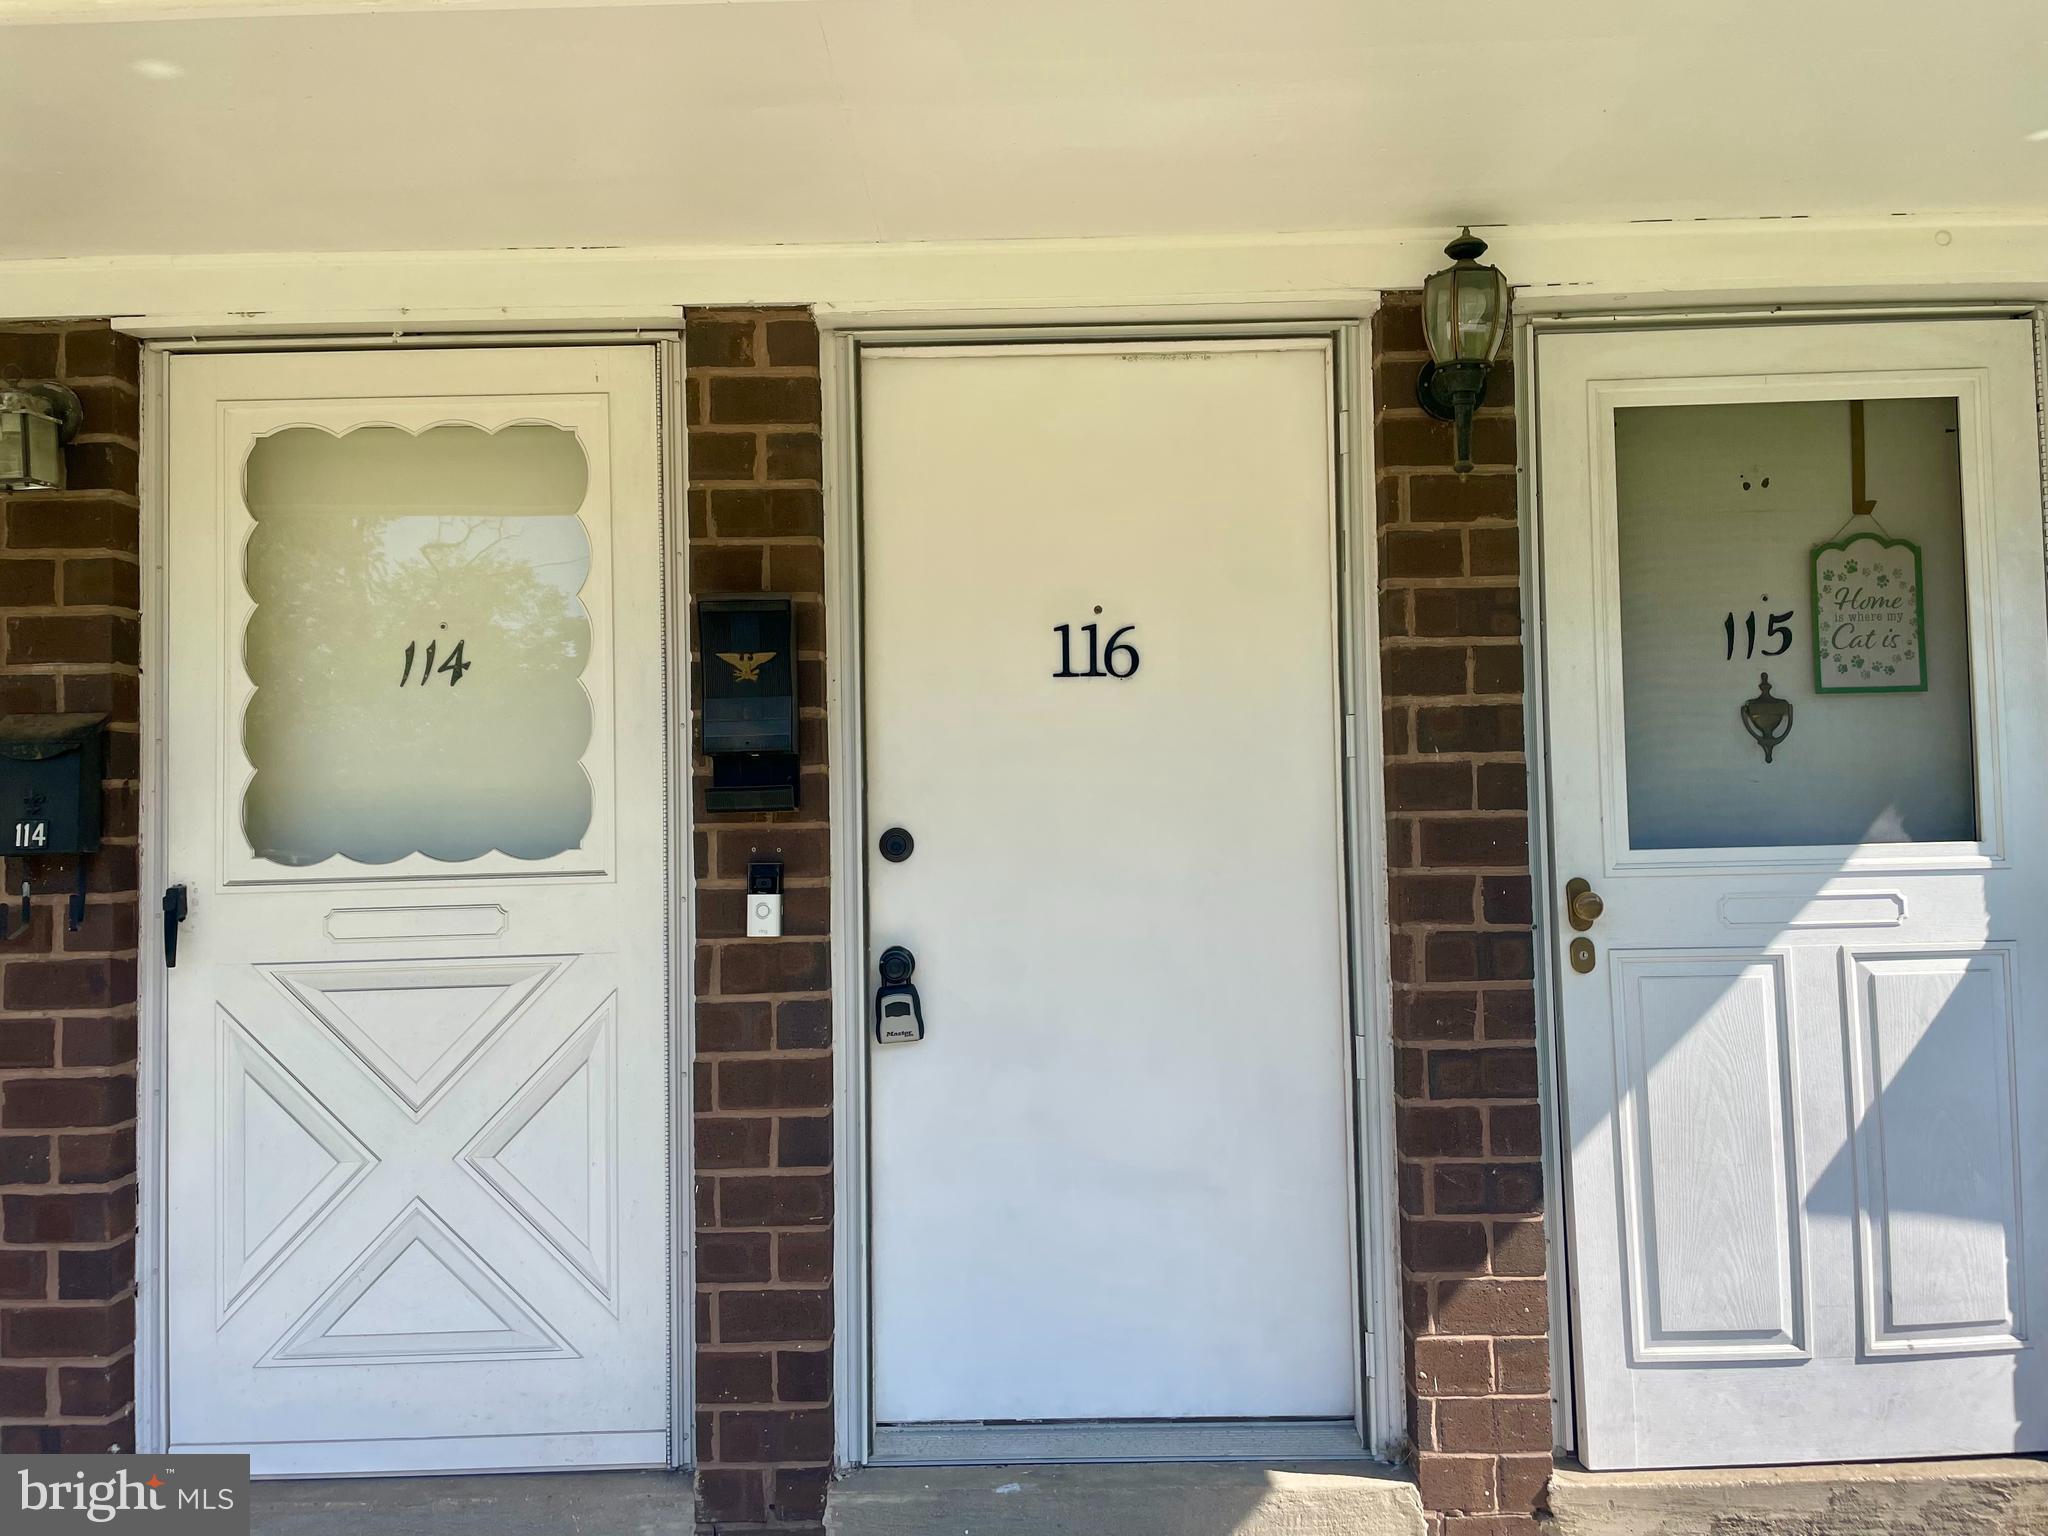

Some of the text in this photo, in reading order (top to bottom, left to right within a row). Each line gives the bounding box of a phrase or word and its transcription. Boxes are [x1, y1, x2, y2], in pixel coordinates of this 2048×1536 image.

[1834, 587, 1903, 610] Home
[1834, 612, 1904, 623] is where my
[1724, 611, 1794, 660] 115
[1831, 623, 1900, 650] Cat is
[400, 639, 471, 687] 114
[1053, 624, 1139, 678] 116
[15, 822, 46, 847] 114
